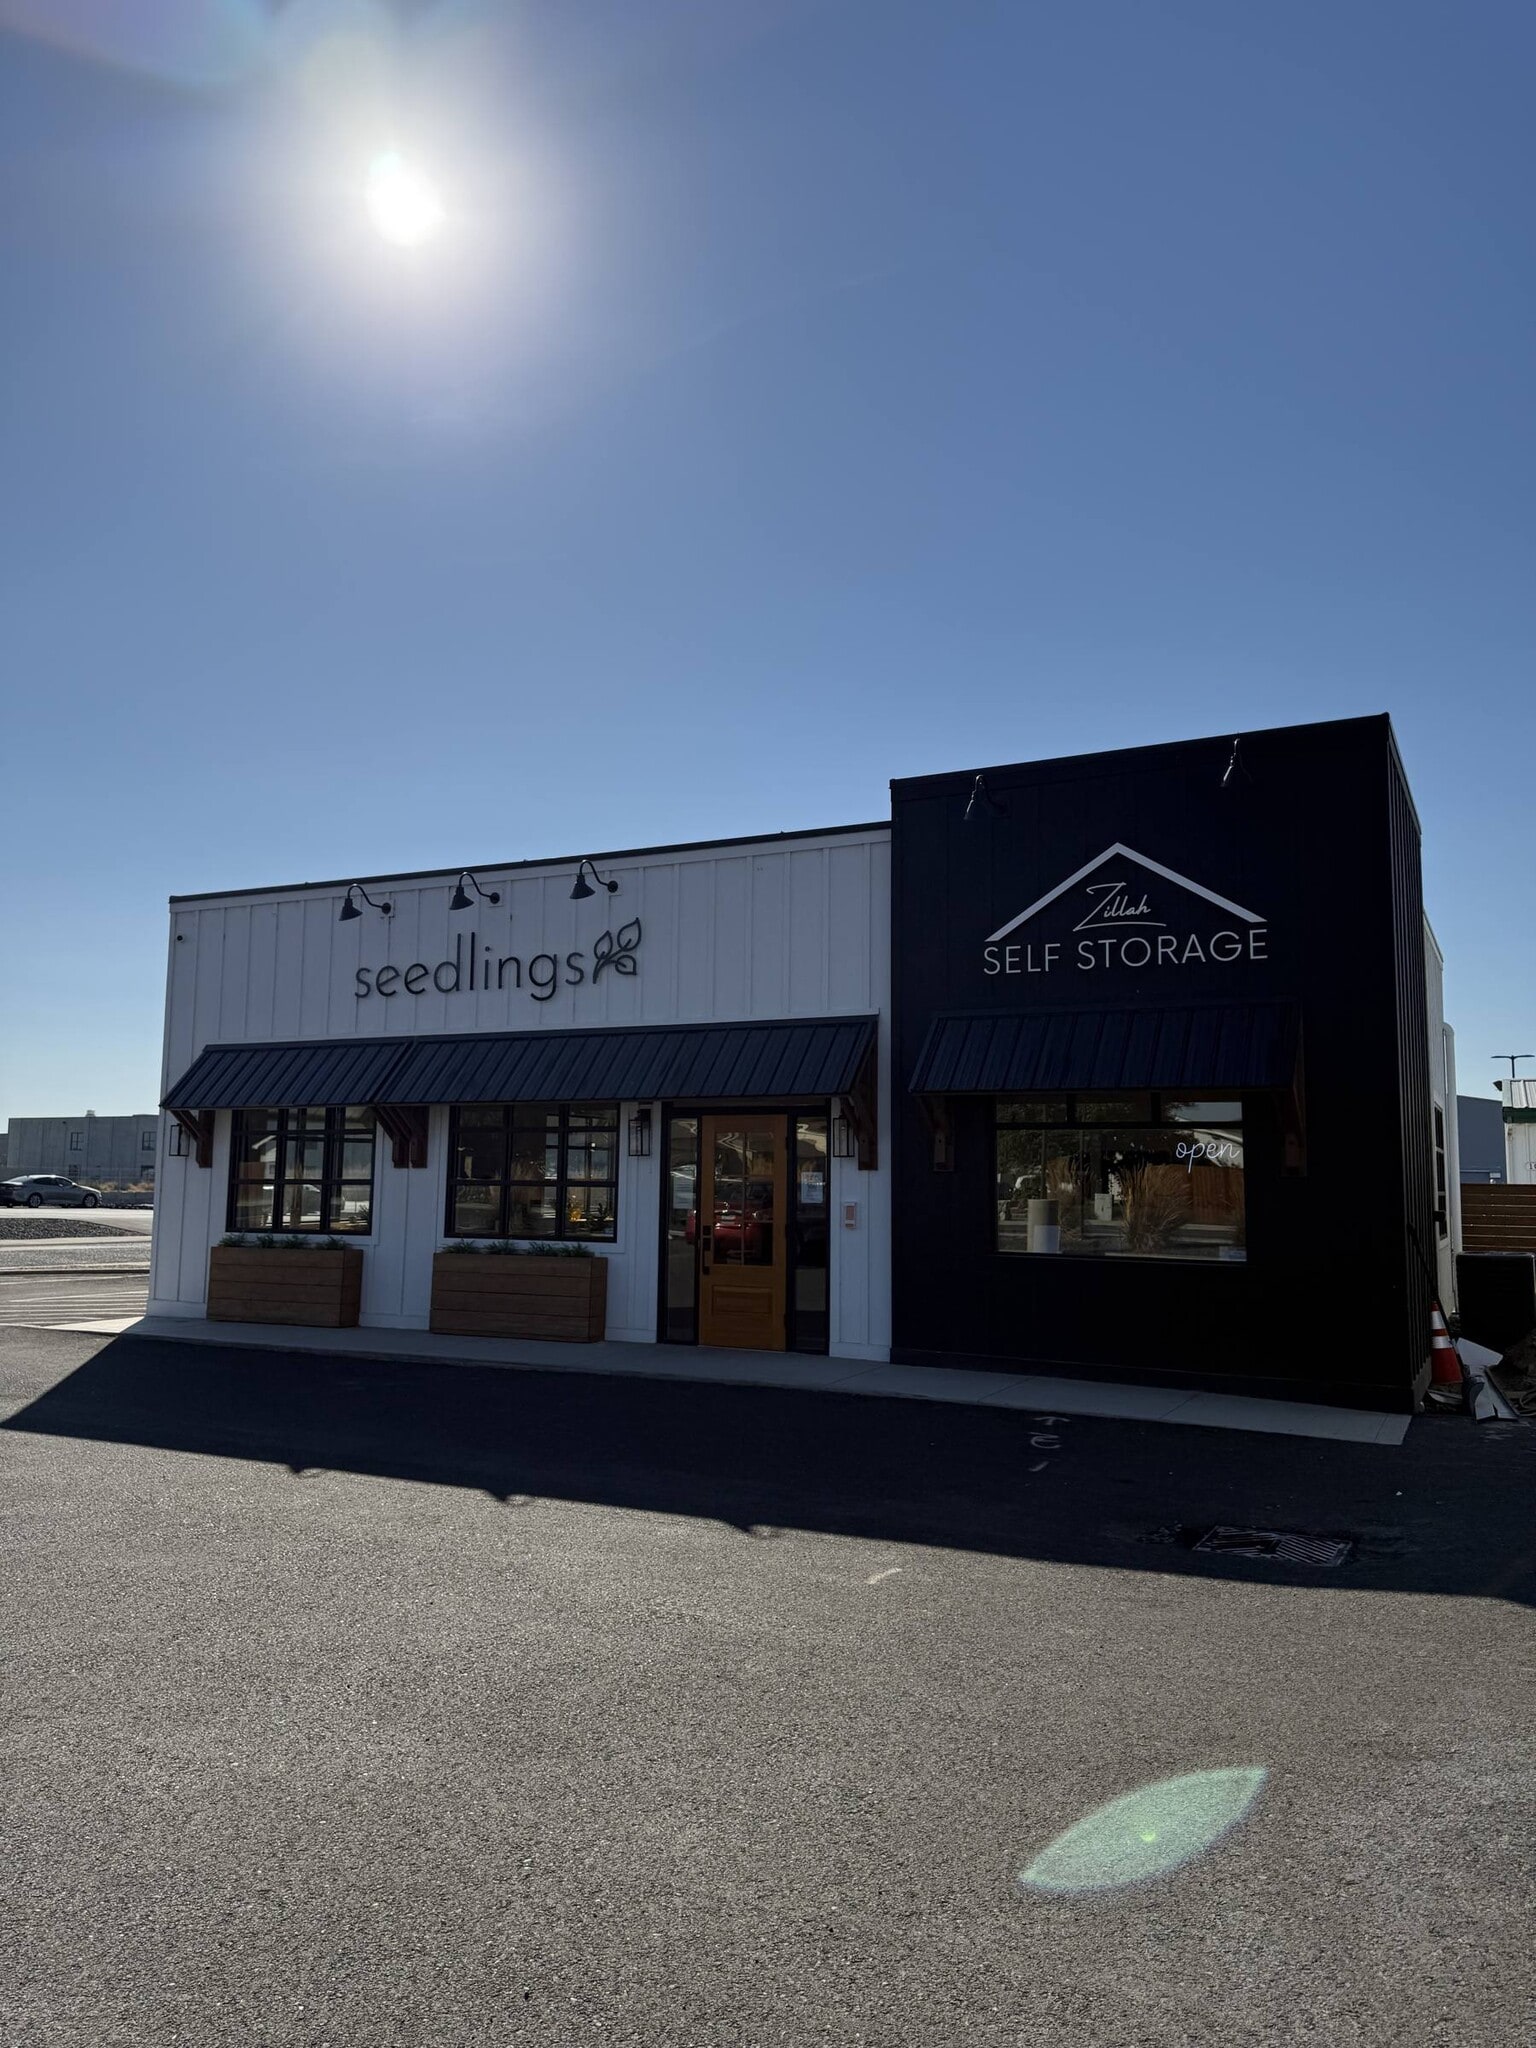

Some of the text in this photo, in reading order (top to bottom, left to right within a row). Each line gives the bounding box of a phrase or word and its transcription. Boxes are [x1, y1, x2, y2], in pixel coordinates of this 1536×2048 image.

[1072, 881, 1167, 932] Zillah
[354, 931, 585, 1001] seedlings
[983, 929, 1269, 975] SELF STORAGE
[1175, 1140, 1241, 1174] open
